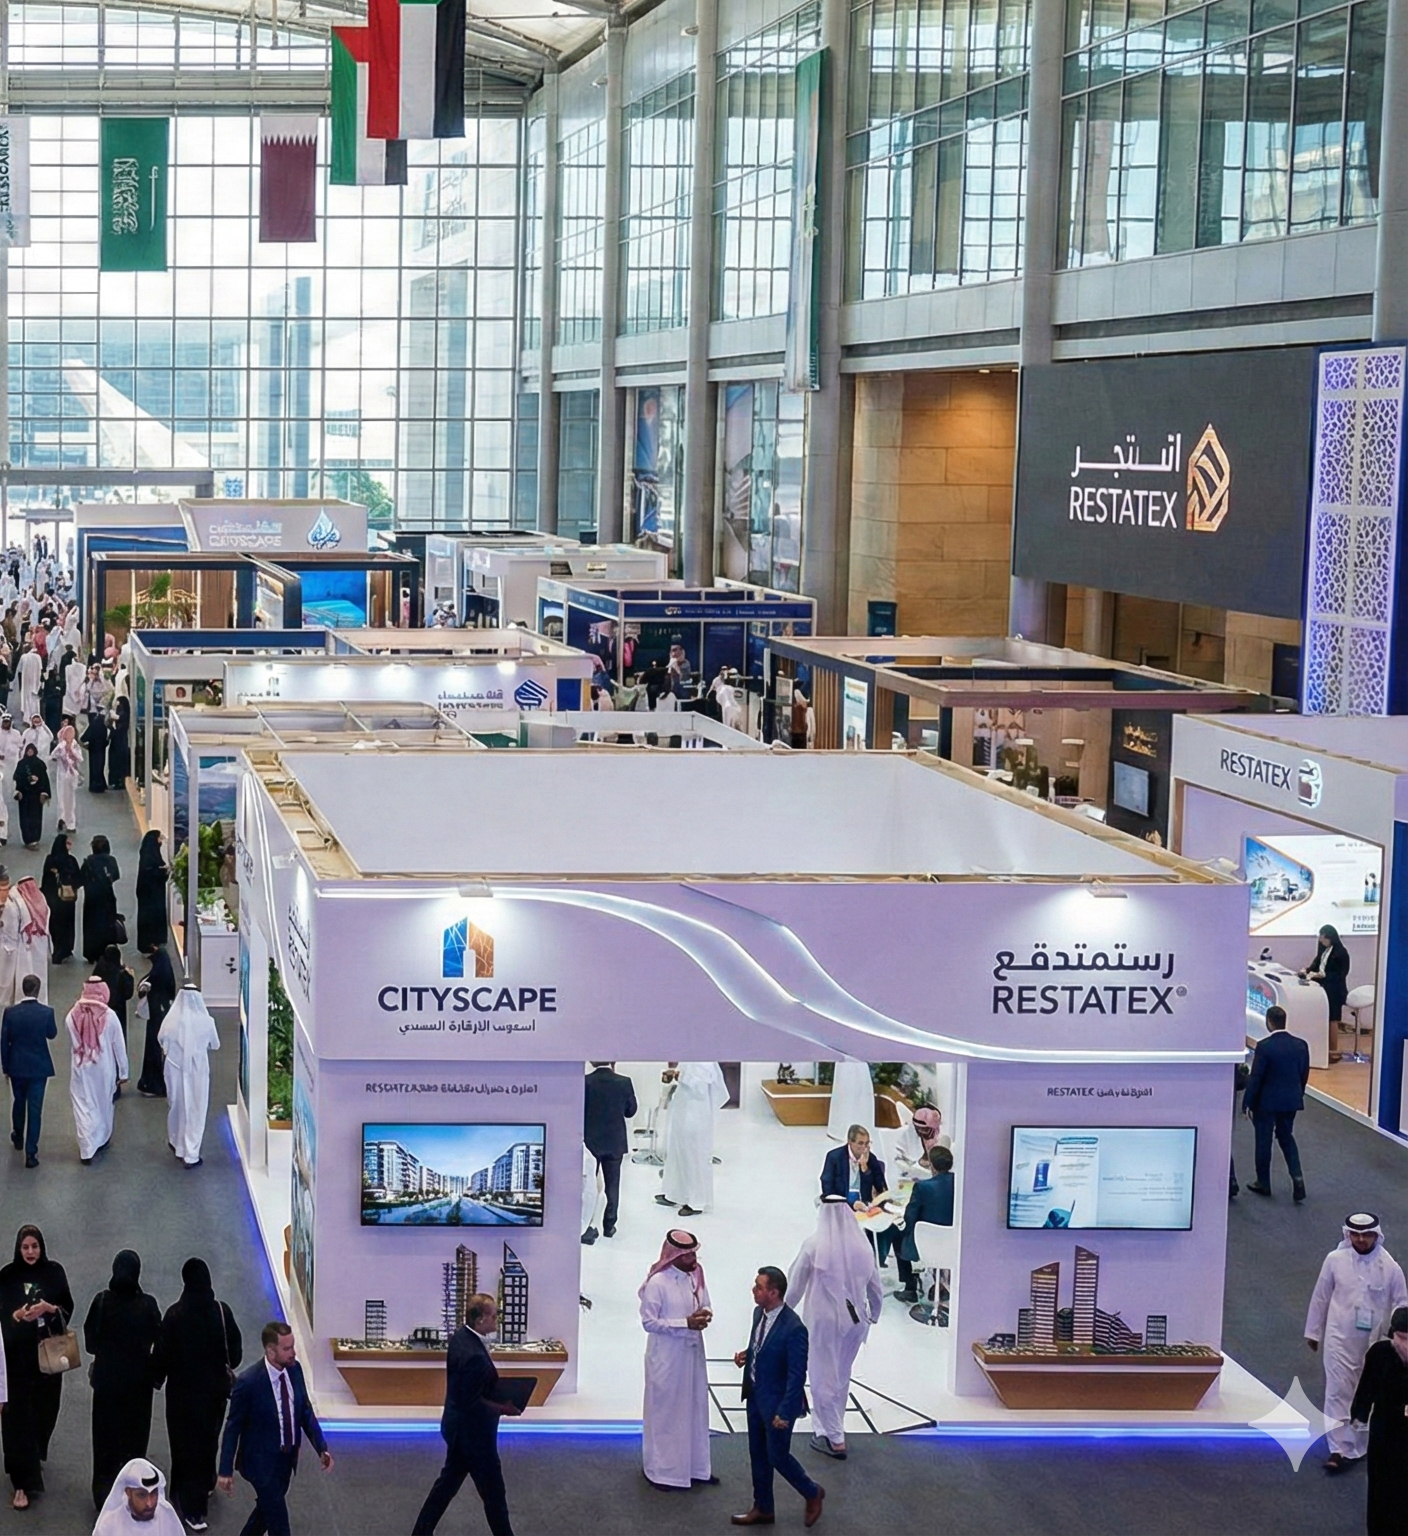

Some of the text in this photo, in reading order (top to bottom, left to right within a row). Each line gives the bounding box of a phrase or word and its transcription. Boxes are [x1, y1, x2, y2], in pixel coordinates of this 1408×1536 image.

[1069, 486, 1178, 529] RESTATEX
[1220, 748, 1291, 791] RESTATEX
[377, 986, 558, 1012] CITYSCAPE
